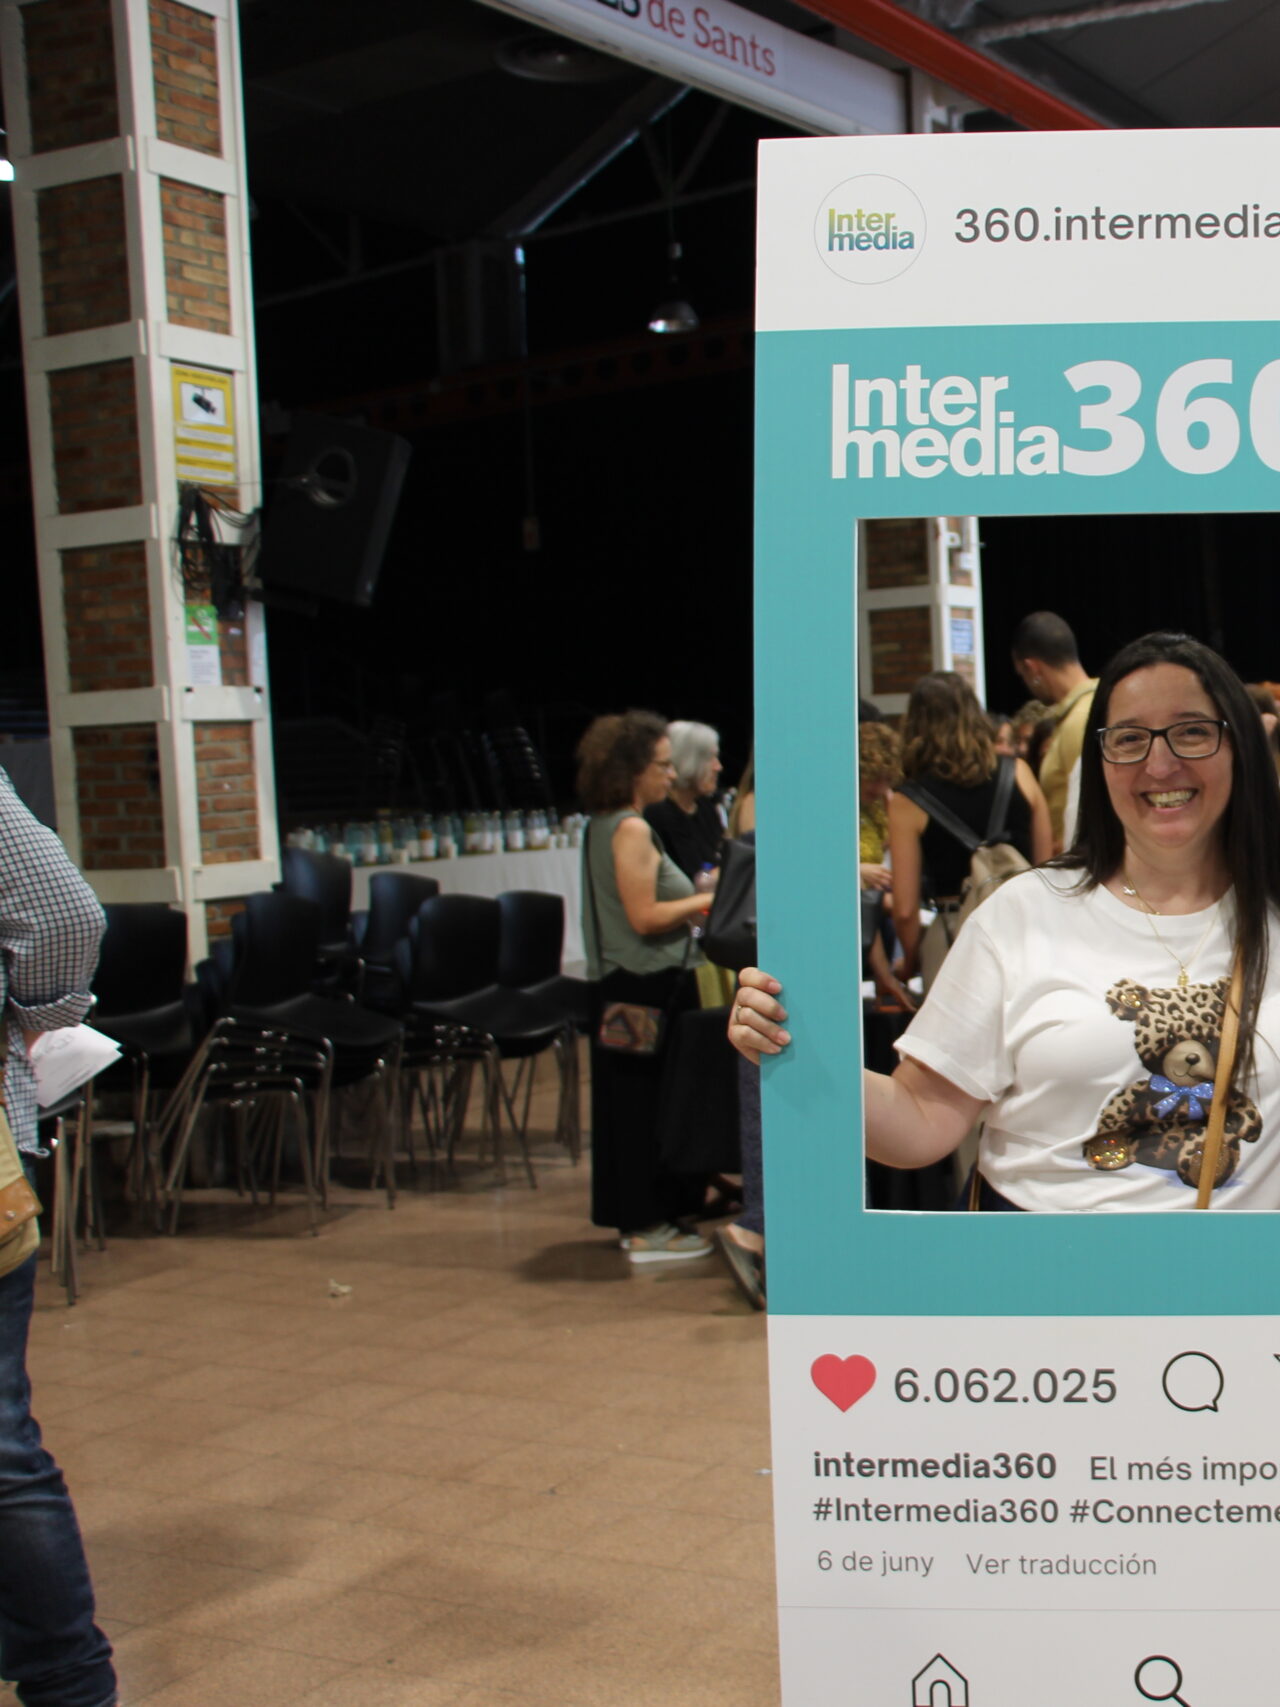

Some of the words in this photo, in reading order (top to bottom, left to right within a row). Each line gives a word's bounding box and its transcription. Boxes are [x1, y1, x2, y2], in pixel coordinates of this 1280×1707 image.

[647, 0, 686, 38] de
[693, 7, 776, 76] Sants
[828, 207, 897, 232] Inter
[828, 225, 915, 252] media
[832, 363, 1009, 428] Inter
[894, 1367, 1117, 1404] 6.062.025
[813, 1450, 1057, 1480] intermedia360
[1090, 1455, 1117, 1480] El
[1128, 1455, 1192, 1481] més
[812, 1497, 1059, 1524] #Intermedia360
[817, 1549, 833, 1571] 6
[841, 1550, 873, 1572] de
[880, 1550, 934, 1578] juny
[966, 1553, 1011, 1575] Ver
[1018, 1552, 1157, 1576] traducción
